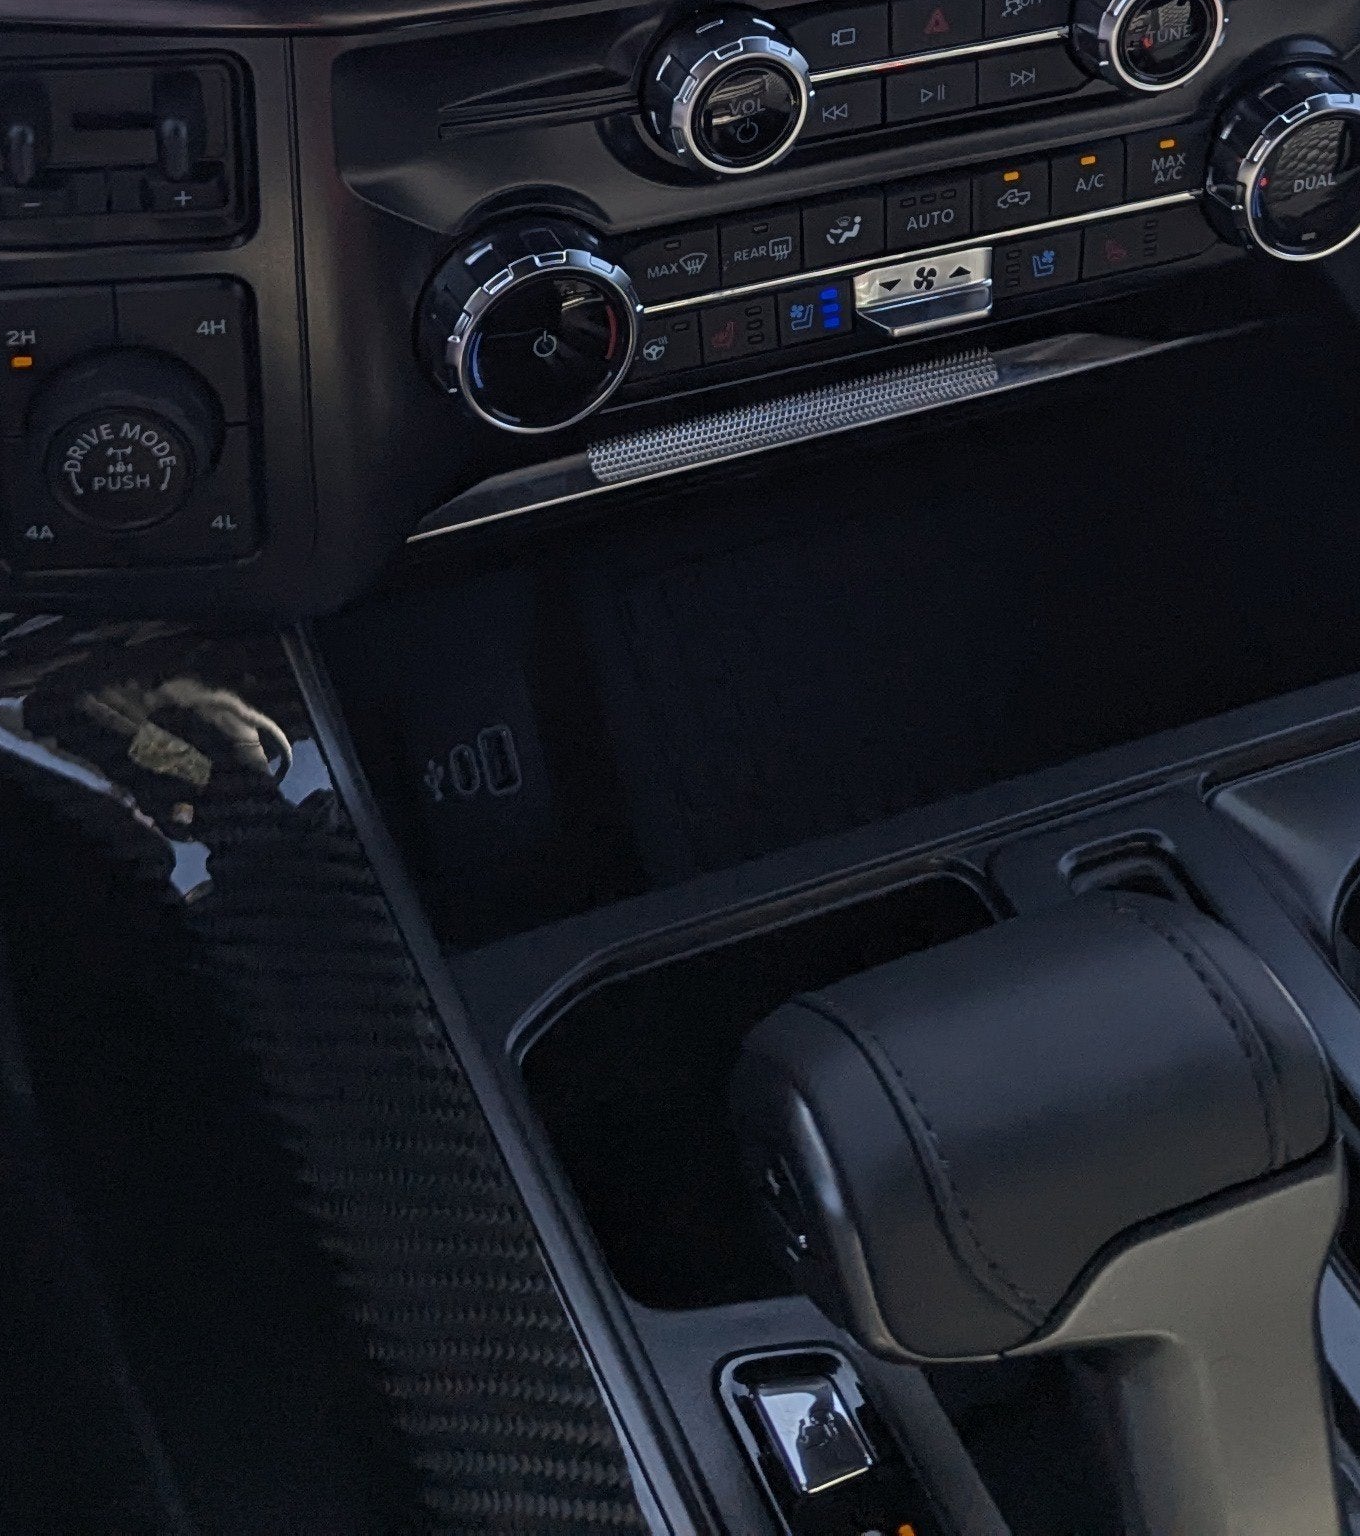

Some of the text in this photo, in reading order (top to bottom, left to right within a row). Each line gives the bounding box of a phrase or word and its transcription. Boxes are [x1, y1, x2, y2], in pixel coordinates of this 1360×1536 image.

[1146, 24, 1191, 44] TUNE
[728, 97, 766, 115] VOL
[1151, 152, 1186, 172] MAX
[1076, 172, 1105, 193] A/C
[1154, 165, 1183, 184] A/C
[1293, 171, 1337, 193] DUAL
[906, 208, 955, 231] AUTO
[733, 245, 767, 263] REAR
[646, 262, 679, 279] MAX
[196, 318, 226, 335] 4H
[6, 329, 36, 346] 2H
[63, 422, 177, 474] DRIVE MODE
[93, 473, 151, 491] PUSH
[211, 514, 238, 530] 4L
[25, 525, 54, 540] 4A
